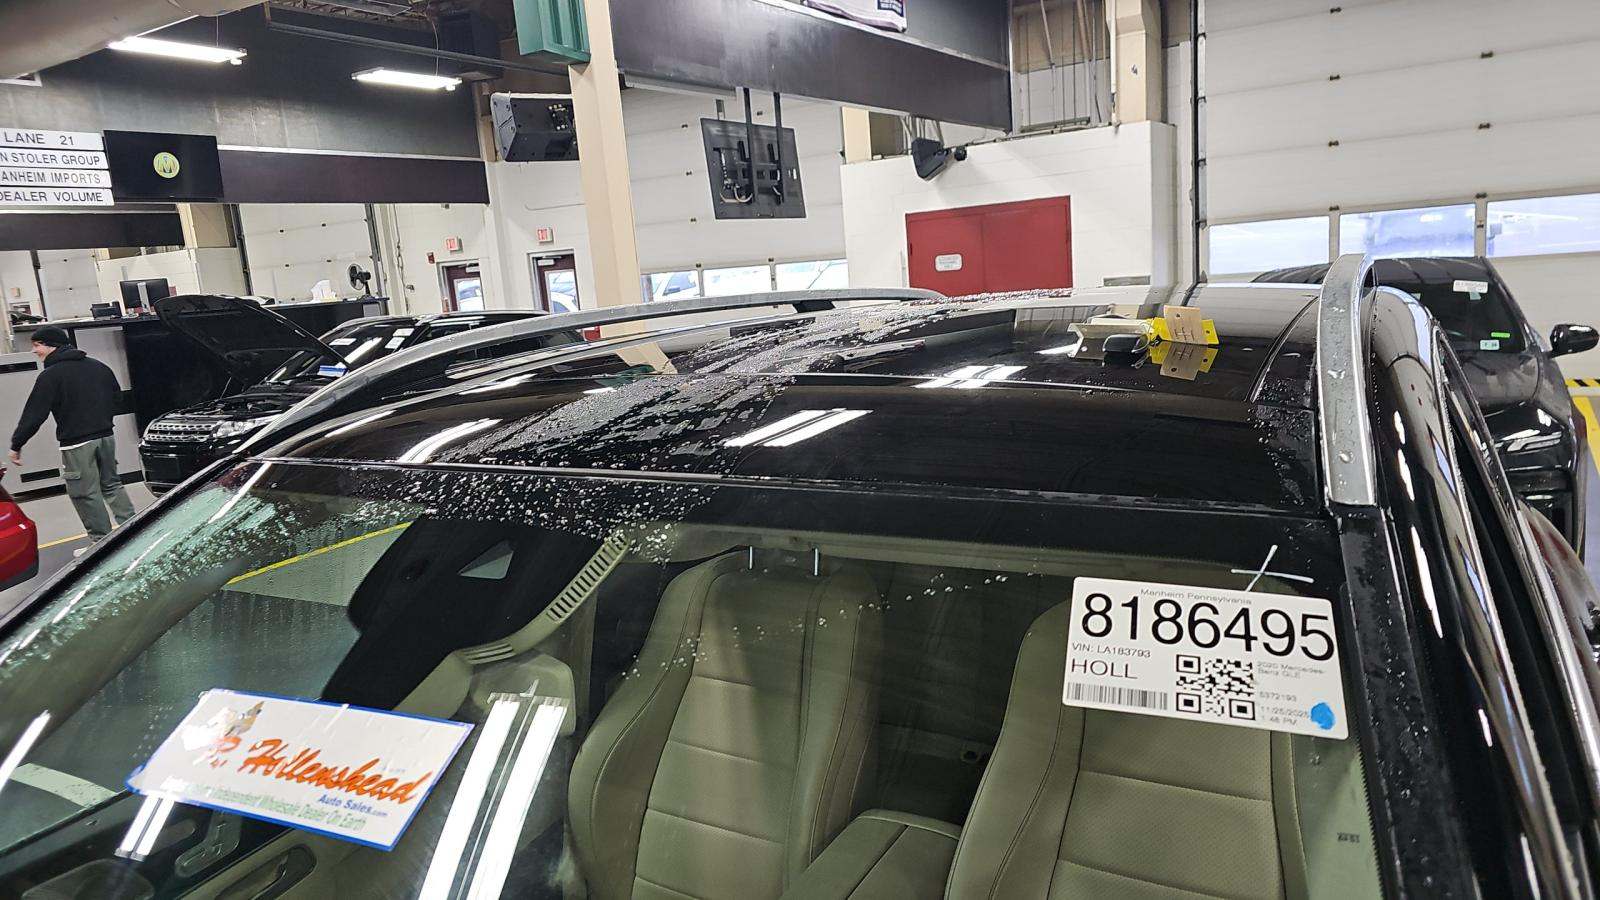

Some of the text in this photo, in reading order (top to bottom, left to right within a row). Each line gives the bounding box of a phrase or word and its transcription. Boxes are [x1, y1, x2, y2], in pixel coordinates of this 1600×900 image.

[4, 131, 74, 146] LANE 21
[11, 152, 58, 164] STOLER
[61, 154, 100, 165] GROUP
[2, 170, 101, 184] ANHEIM IMPORTS
[53, 192, 103, 202] VOLUME
[1140, 588, 1252, 605] Manheim Pennsylvania
[1081, 592, 1334, 661] 8186495
[1072, 642, 1151, 658] VIN: LA183793
[1071, 658, 1138, 680] HOLL
[238, 739, 433, 804] Hollenshead
[318, 794, 342, 807] Auto
